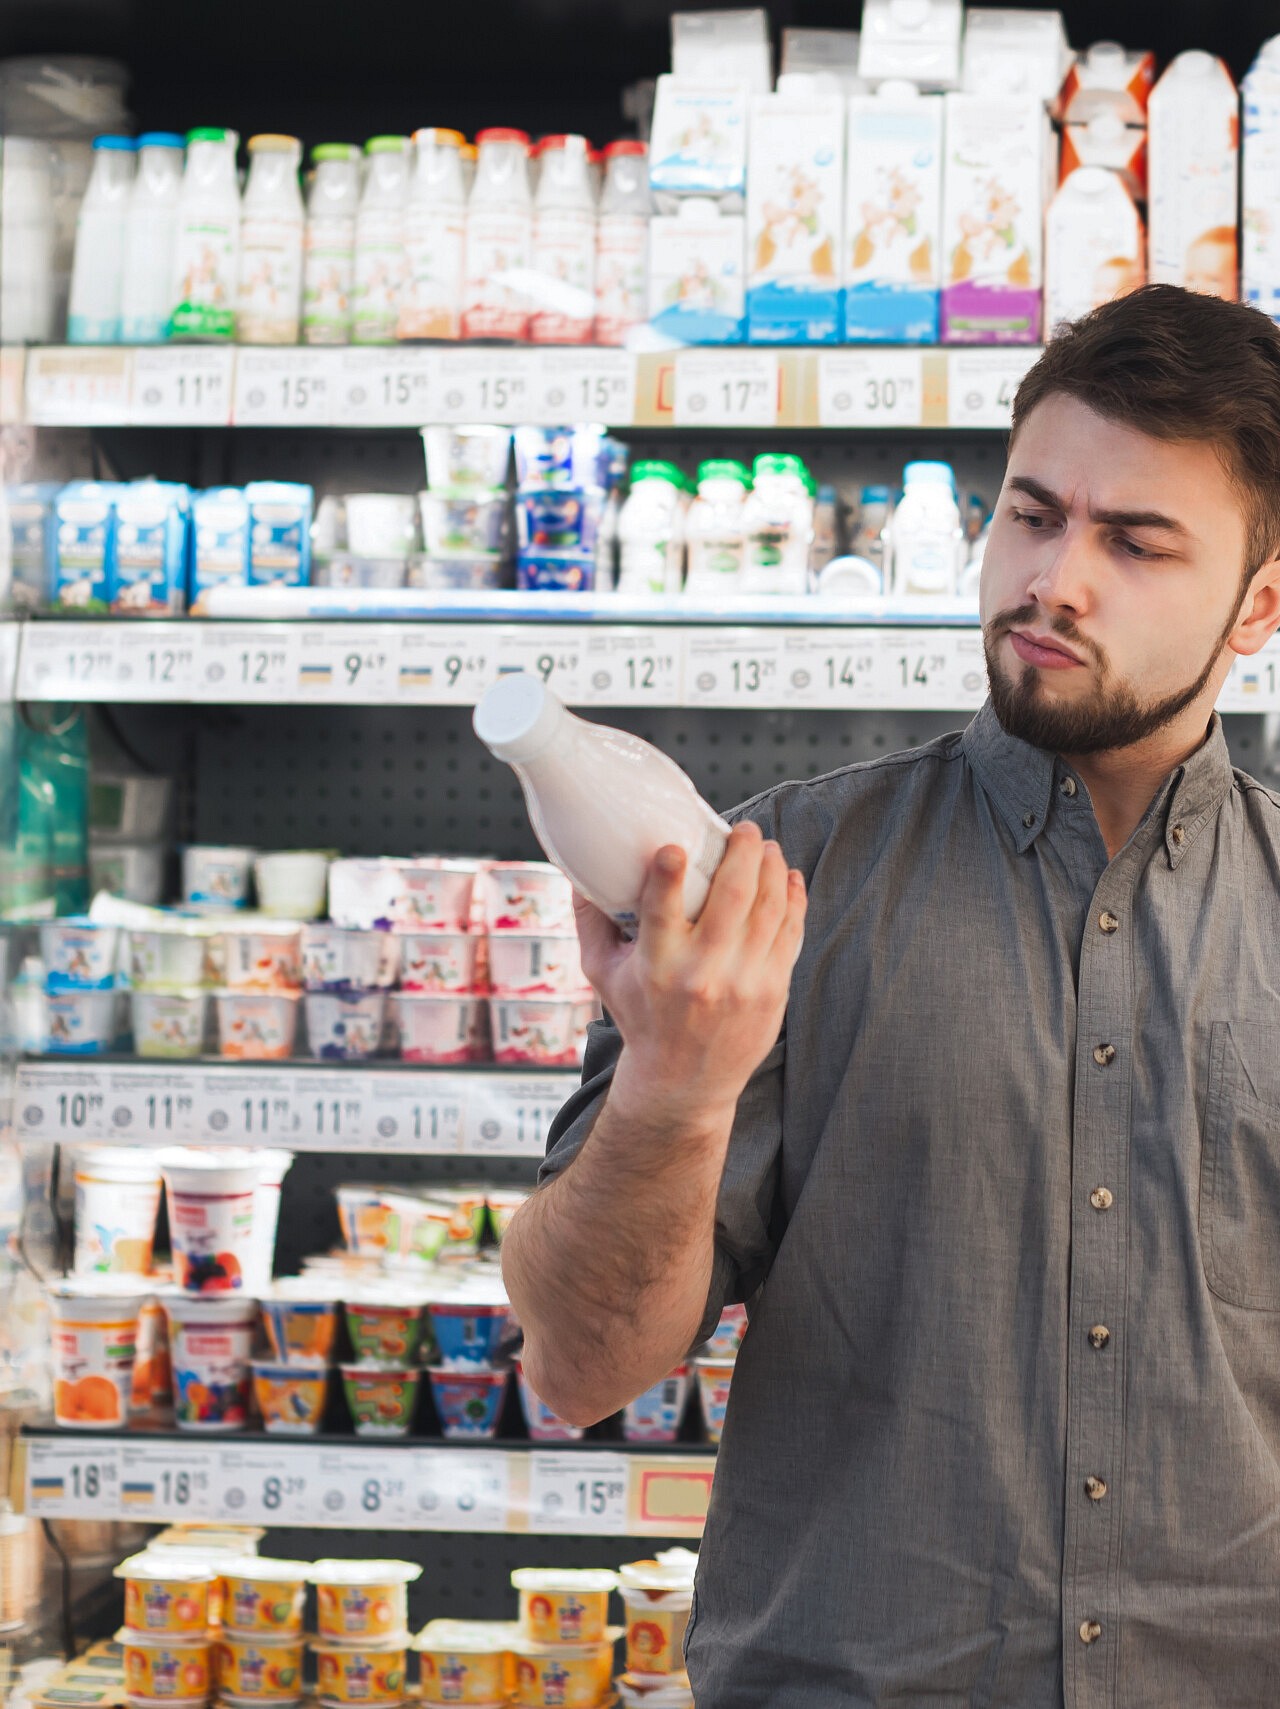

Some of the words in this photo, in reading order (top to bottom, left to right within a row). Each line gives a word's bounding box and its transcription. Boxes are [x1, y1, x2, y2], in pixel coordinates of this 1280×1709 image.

[345, 652, 362, 685] 9
[445, 654, 462, 687] 9
[537, 653, 554, 684] 9
[626, 656, 655, 688] 12
[732, 660, 760, 692] 13
[826, 656, 854, 689] 14
[899, 655, 928, 688] 14
[58, 1092, 86, 1127] 10
[146, 1094, 172, 1130] 11
[242, 1097, 268, 1132] 11
[314, 1099, 340, 1134] 11
[412, 1104, 438, 1139] 11
[70, 1464, 100, 1498] 18
[161, 1471, 190, 1505] 18
[263, 1476, 281, 1510] 8
[362, 1479, 381, 1512] 8
[576, 1481, 606, 1515] 15
